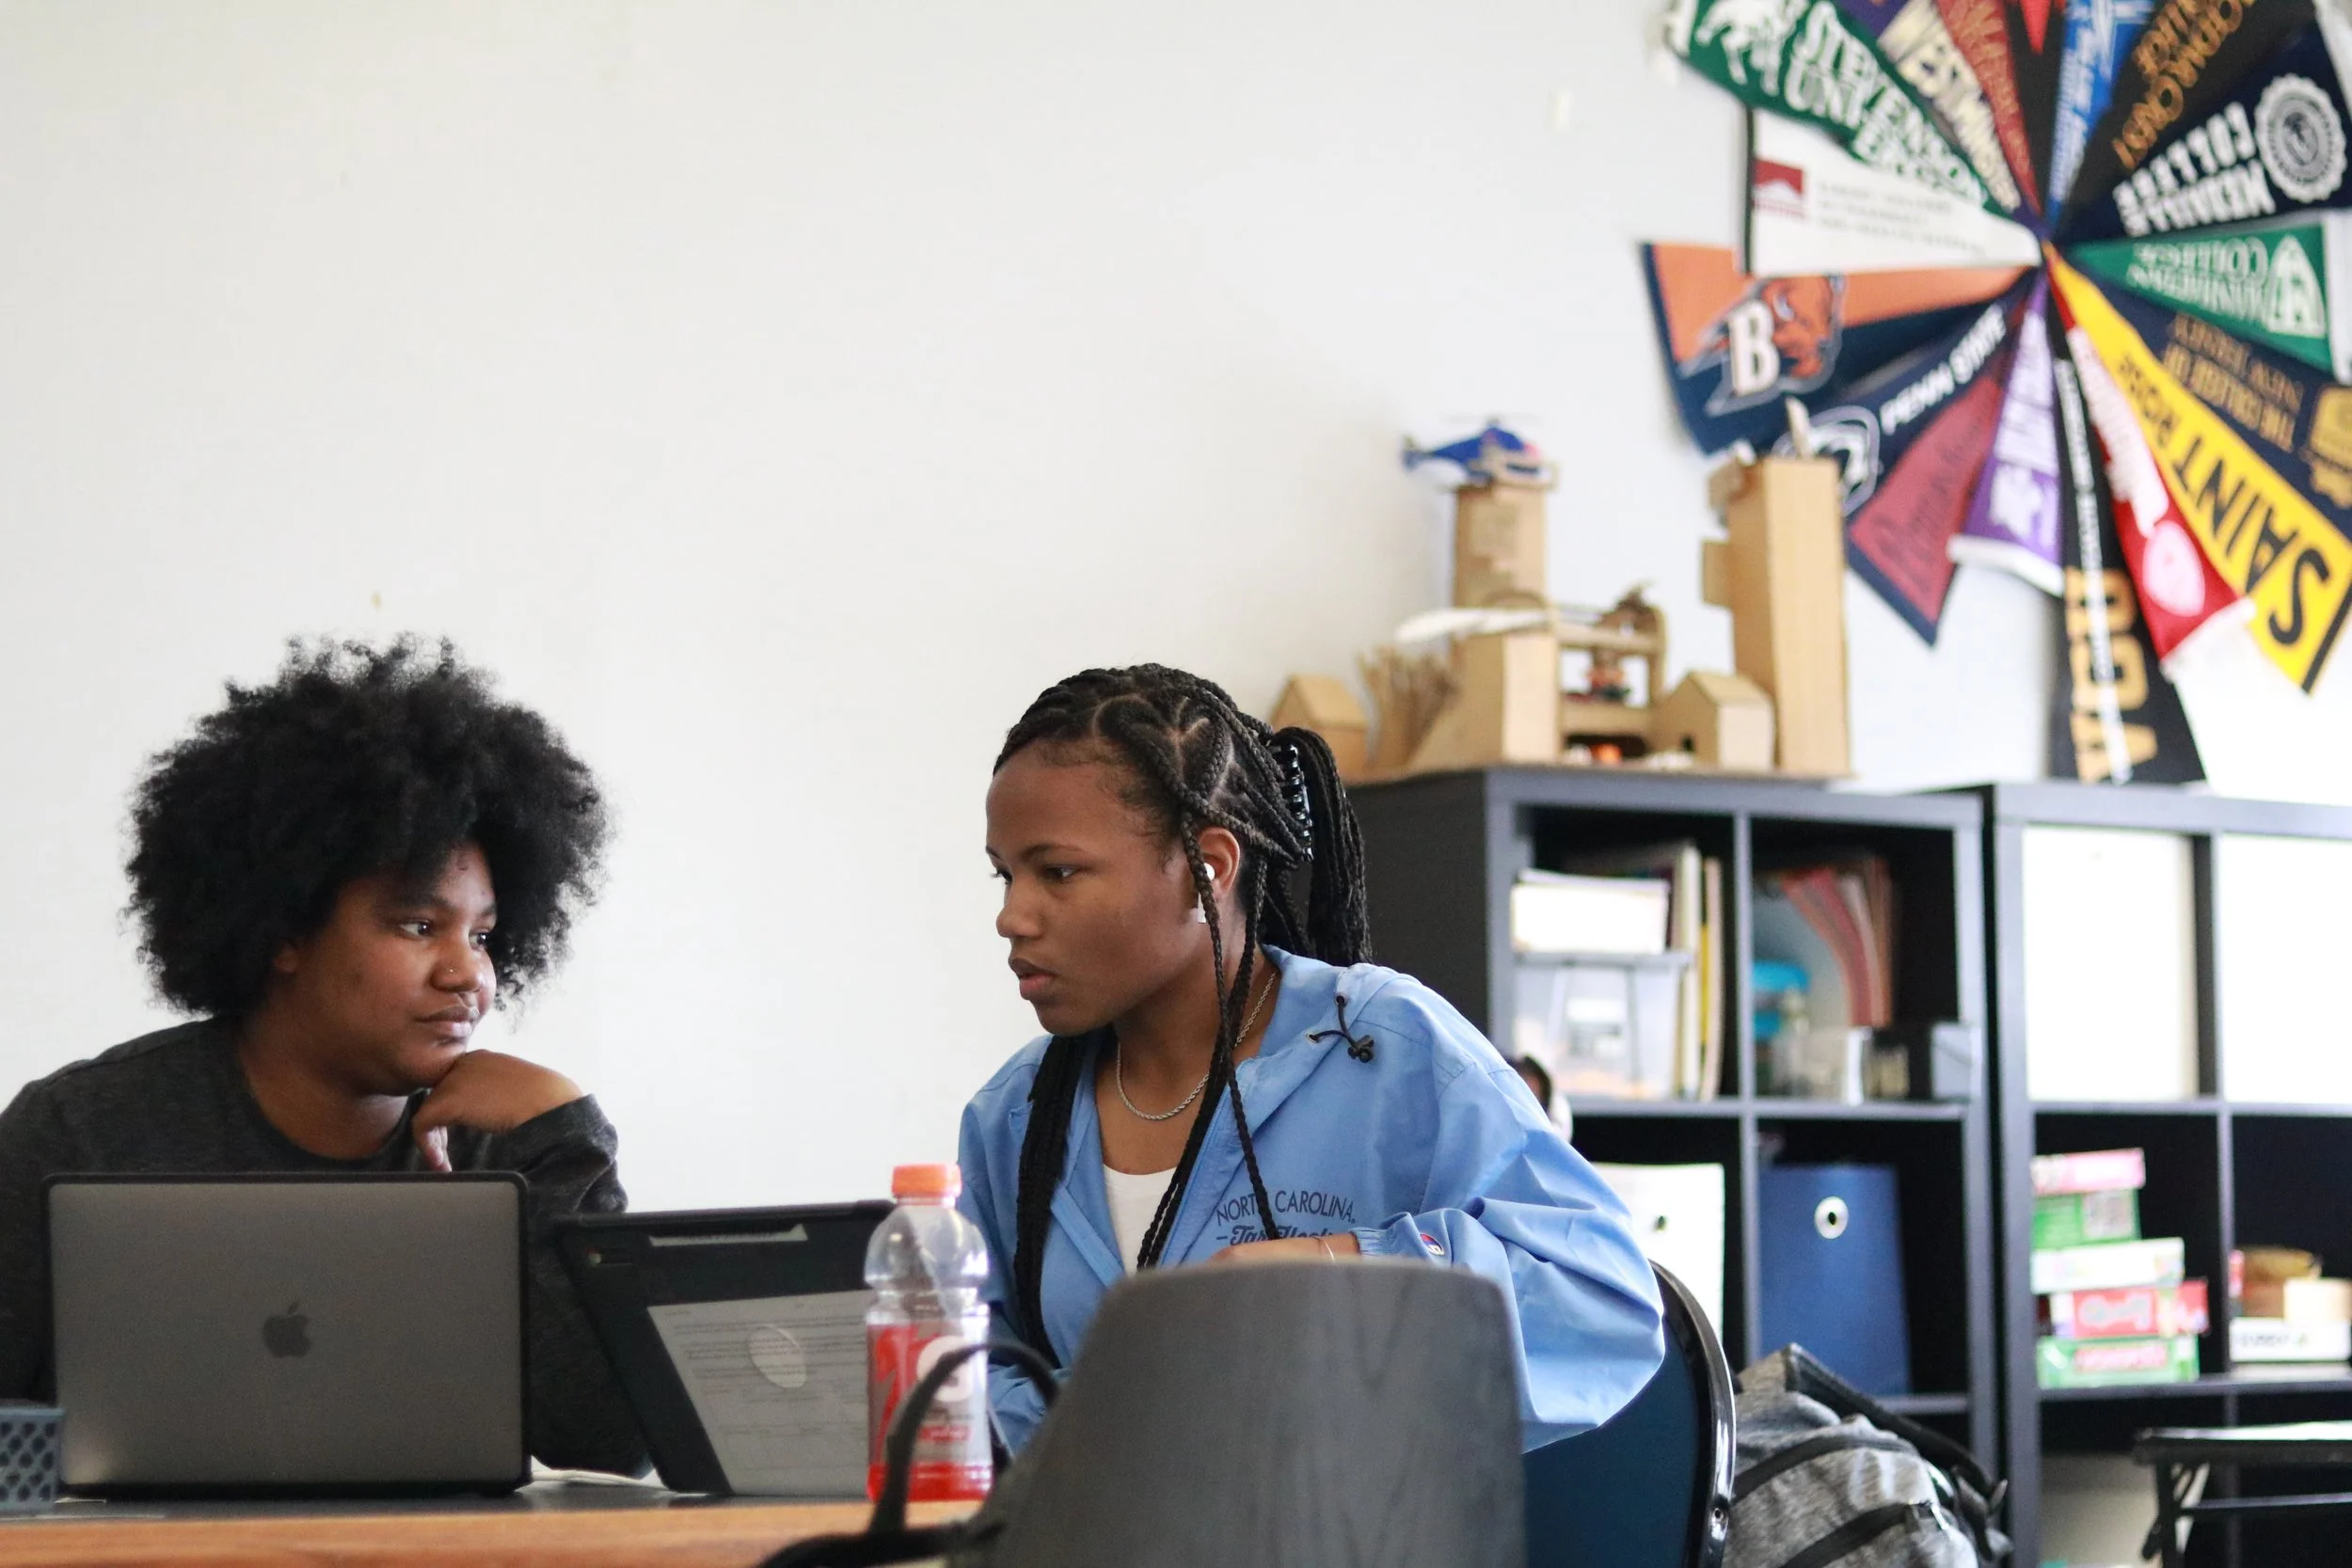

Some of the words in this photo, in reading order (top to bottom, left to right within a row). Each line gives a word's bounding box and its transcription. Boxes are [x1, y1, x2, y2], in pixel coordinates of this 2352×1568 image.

[2112, 102, 2256, 211] COLLEGE
[2132, 237, 2269, 283] COLLEGE
[1728, 300, 1780, 397] B
[1880, 360, 1955, 436] PENN
[1949, 302, 2007, 384] STATE
[2172, 436, 2329, 645] SAINT
[1216, 1192, 1262, 1227] NORT
